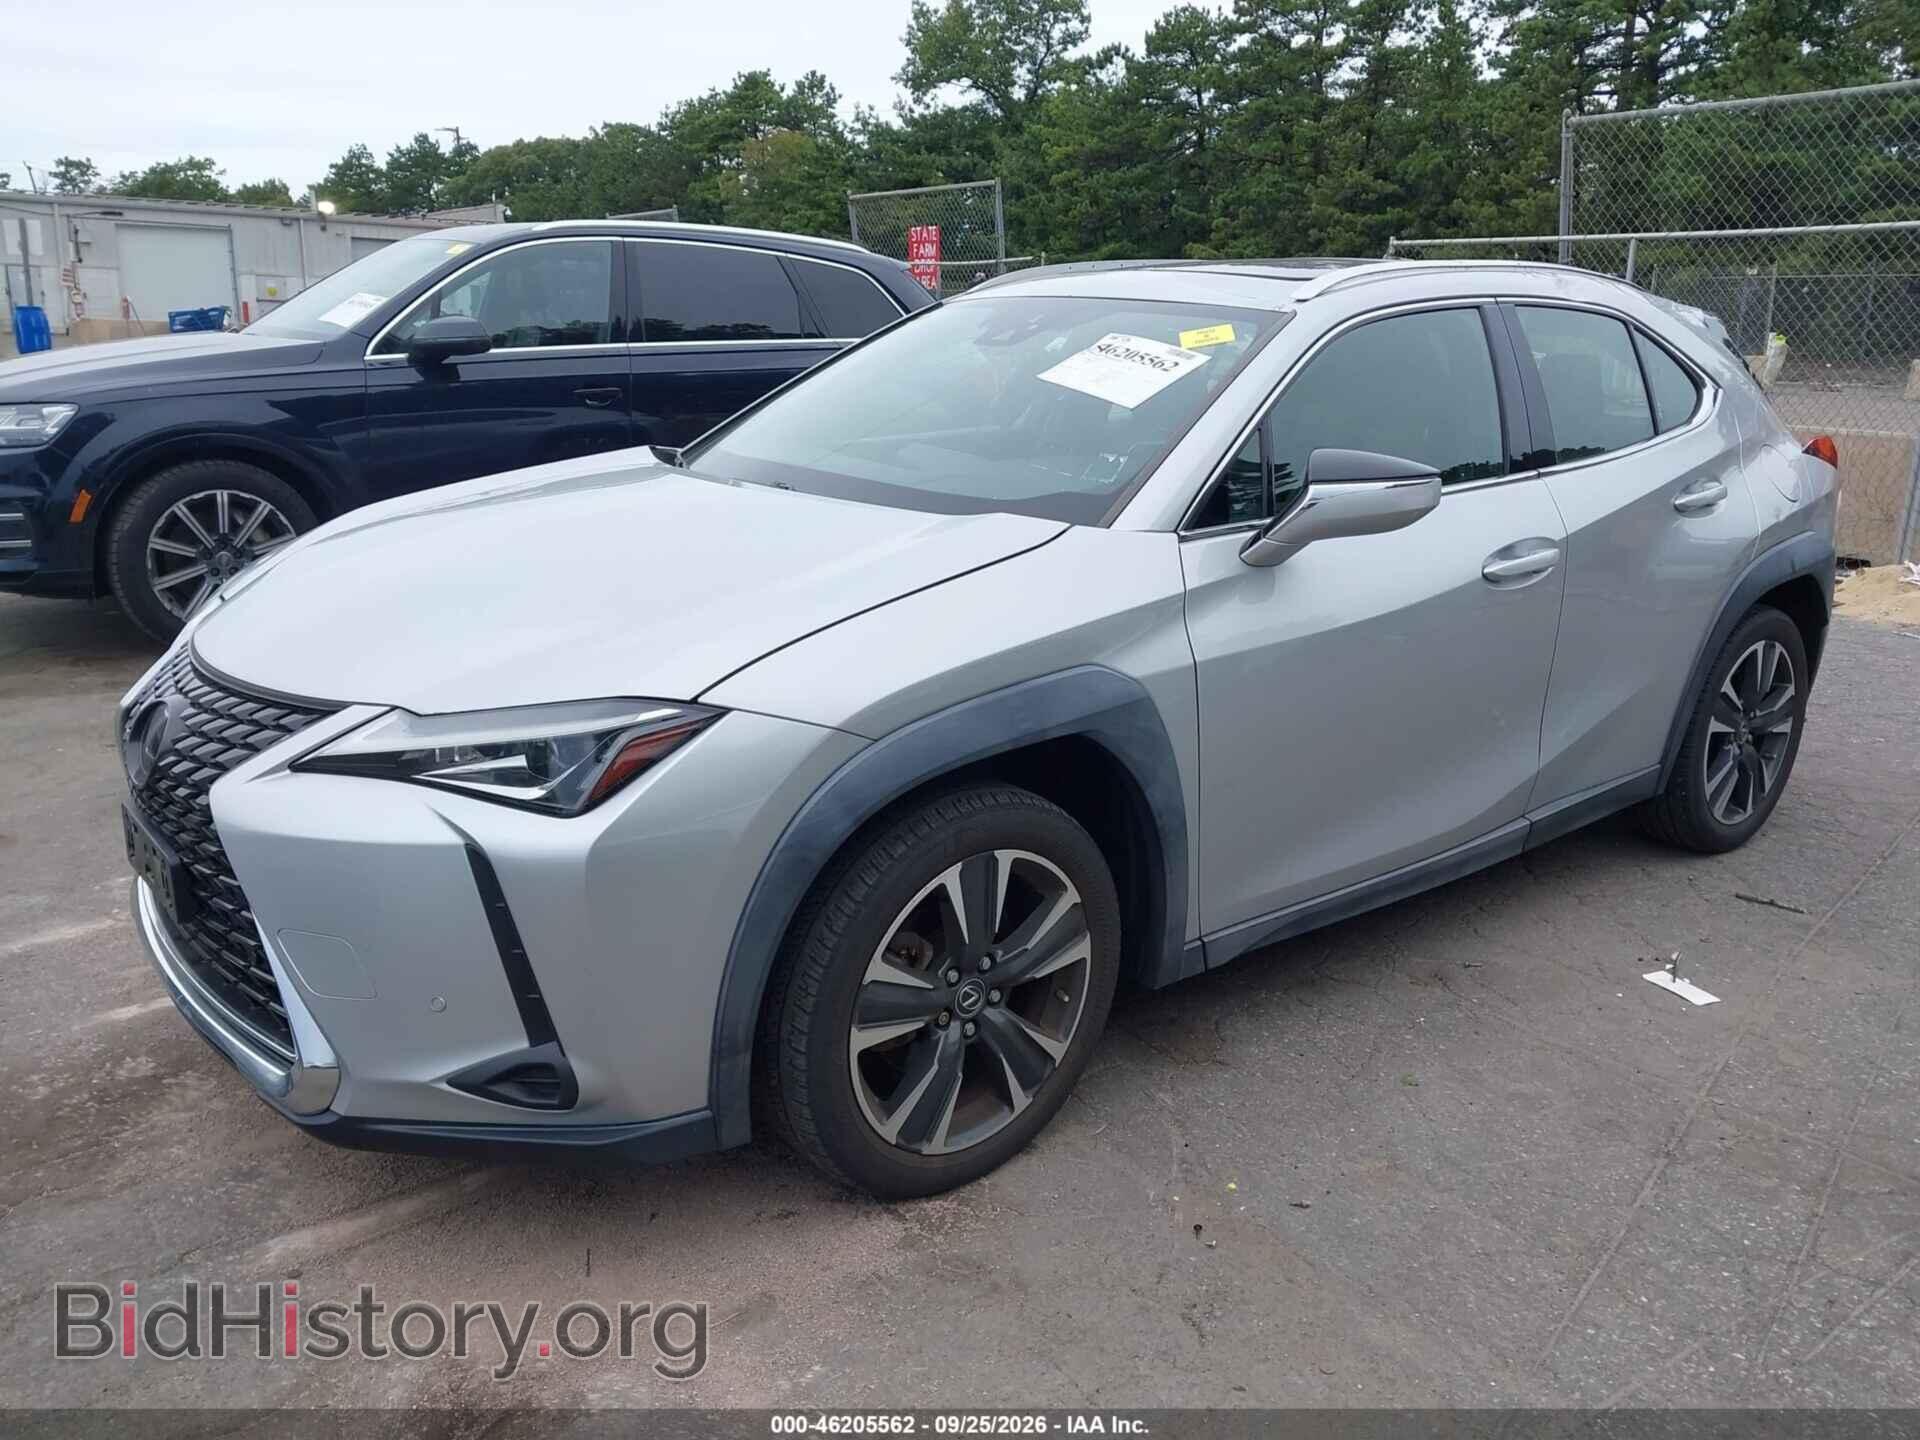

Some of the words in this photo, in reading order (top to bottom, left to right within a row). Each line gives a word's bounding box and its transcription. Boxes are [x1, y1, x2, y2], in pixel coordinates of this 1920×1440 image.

[911, 226, 937, 241] STATE
[913, 243, 936, 257] FARM
[1097, 343, 1179, 371] 46205562
